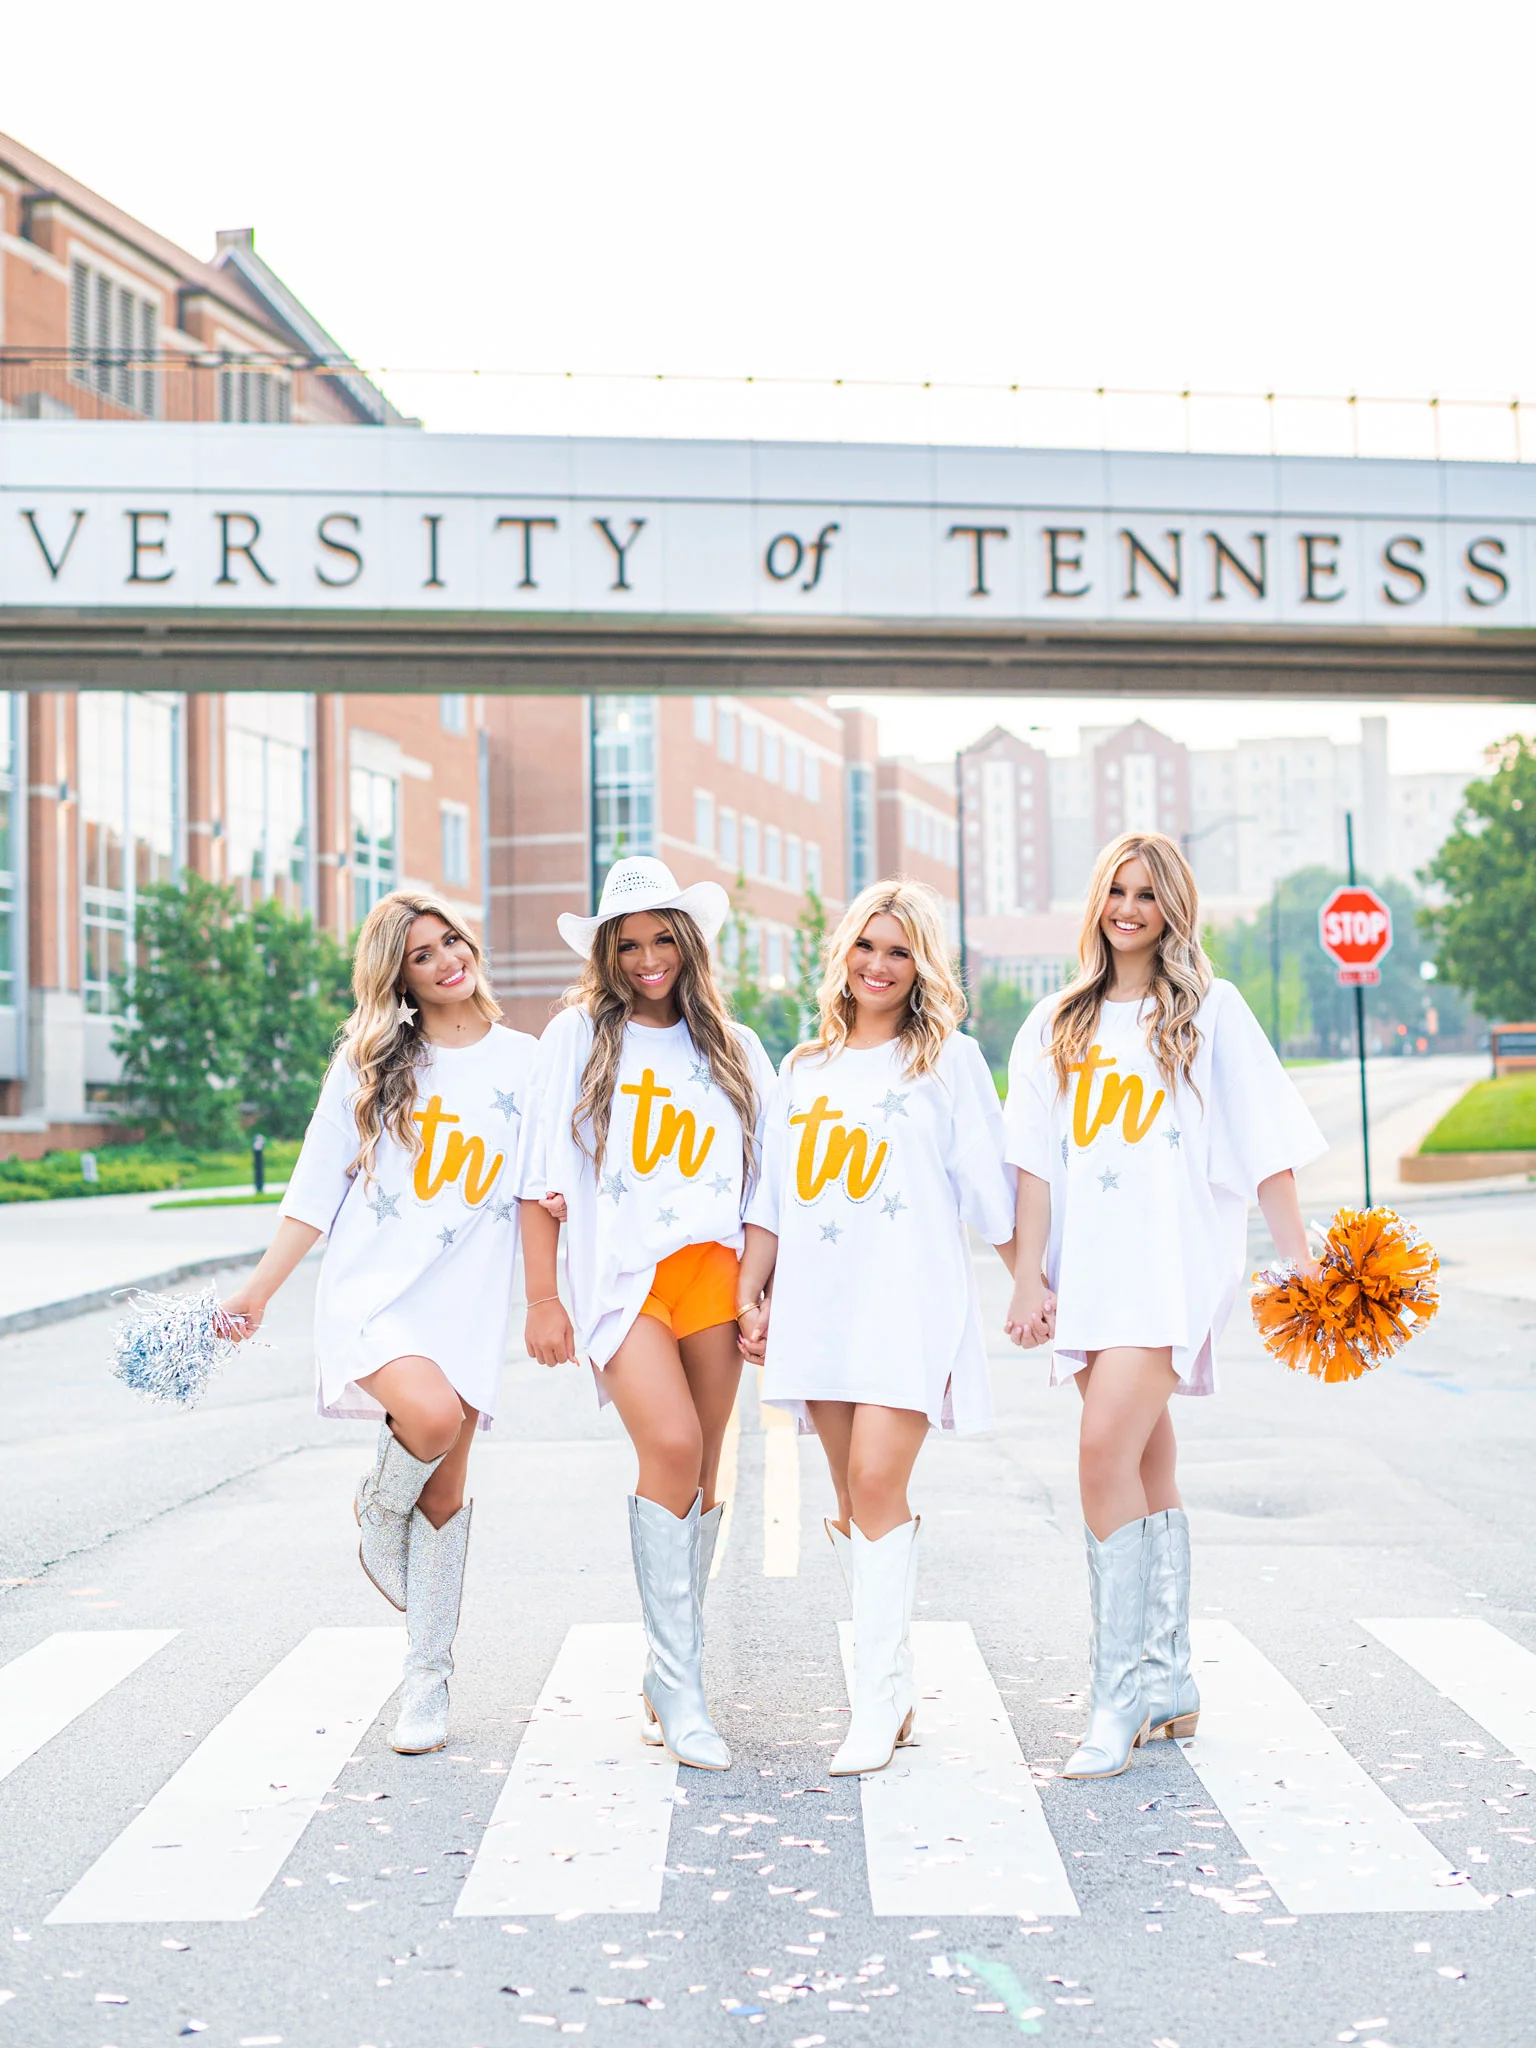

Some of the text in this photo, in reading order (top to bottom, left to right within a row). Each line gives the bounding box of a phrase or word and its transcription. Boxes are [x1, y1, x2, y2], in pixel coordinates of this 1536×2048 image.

[763, 522, 840, 593] of
[1325, 911, 1387, 946] STOP
[620, 1067, 716, 1178] tn
[789, 1095, 888, 1202] tn
[1066, 1044, 1166, 1148] tn
[413, 1094, 504, 1205] tn
